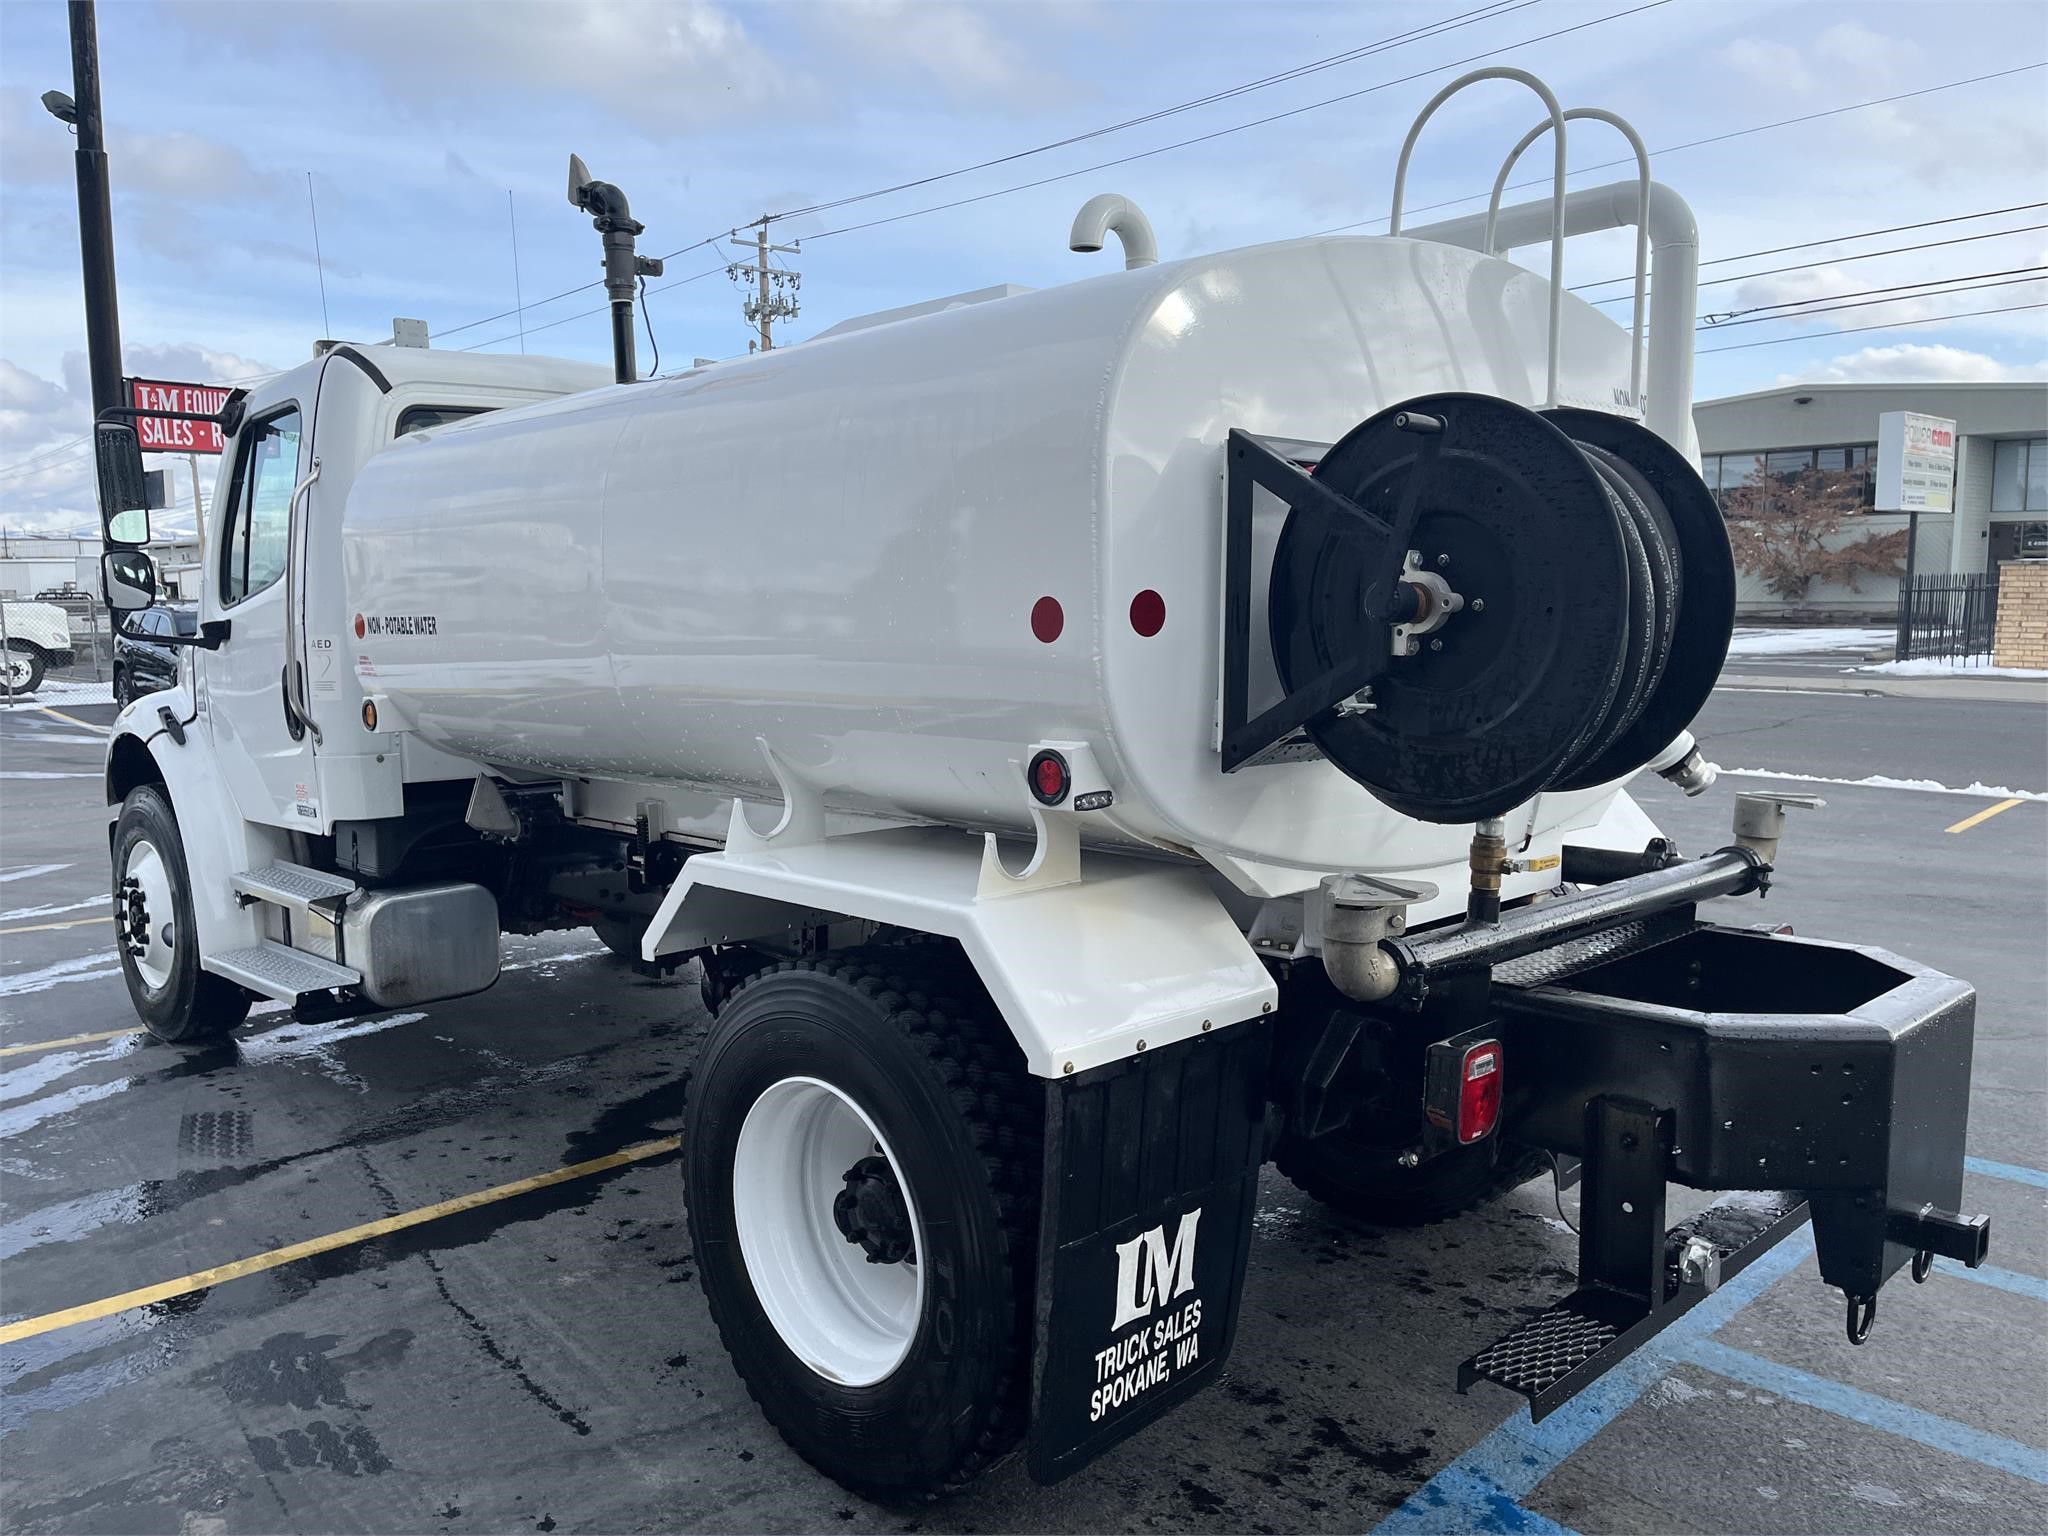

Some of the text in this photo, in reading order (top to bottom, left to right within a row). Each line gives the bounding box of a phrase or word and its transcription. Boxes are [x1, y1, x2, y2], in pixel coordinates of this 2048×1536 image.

[142, 416, 195, 447] SALES
[367, 616, 382, 634] NON
[385, 616, 414, 635] POTABLE
[413, 616, 437, 636] WATER
[1095, 1298, 1202, 1384] TRUCK SALES
[1090, 1333, 1199, 1422] SPOKANE, WA
